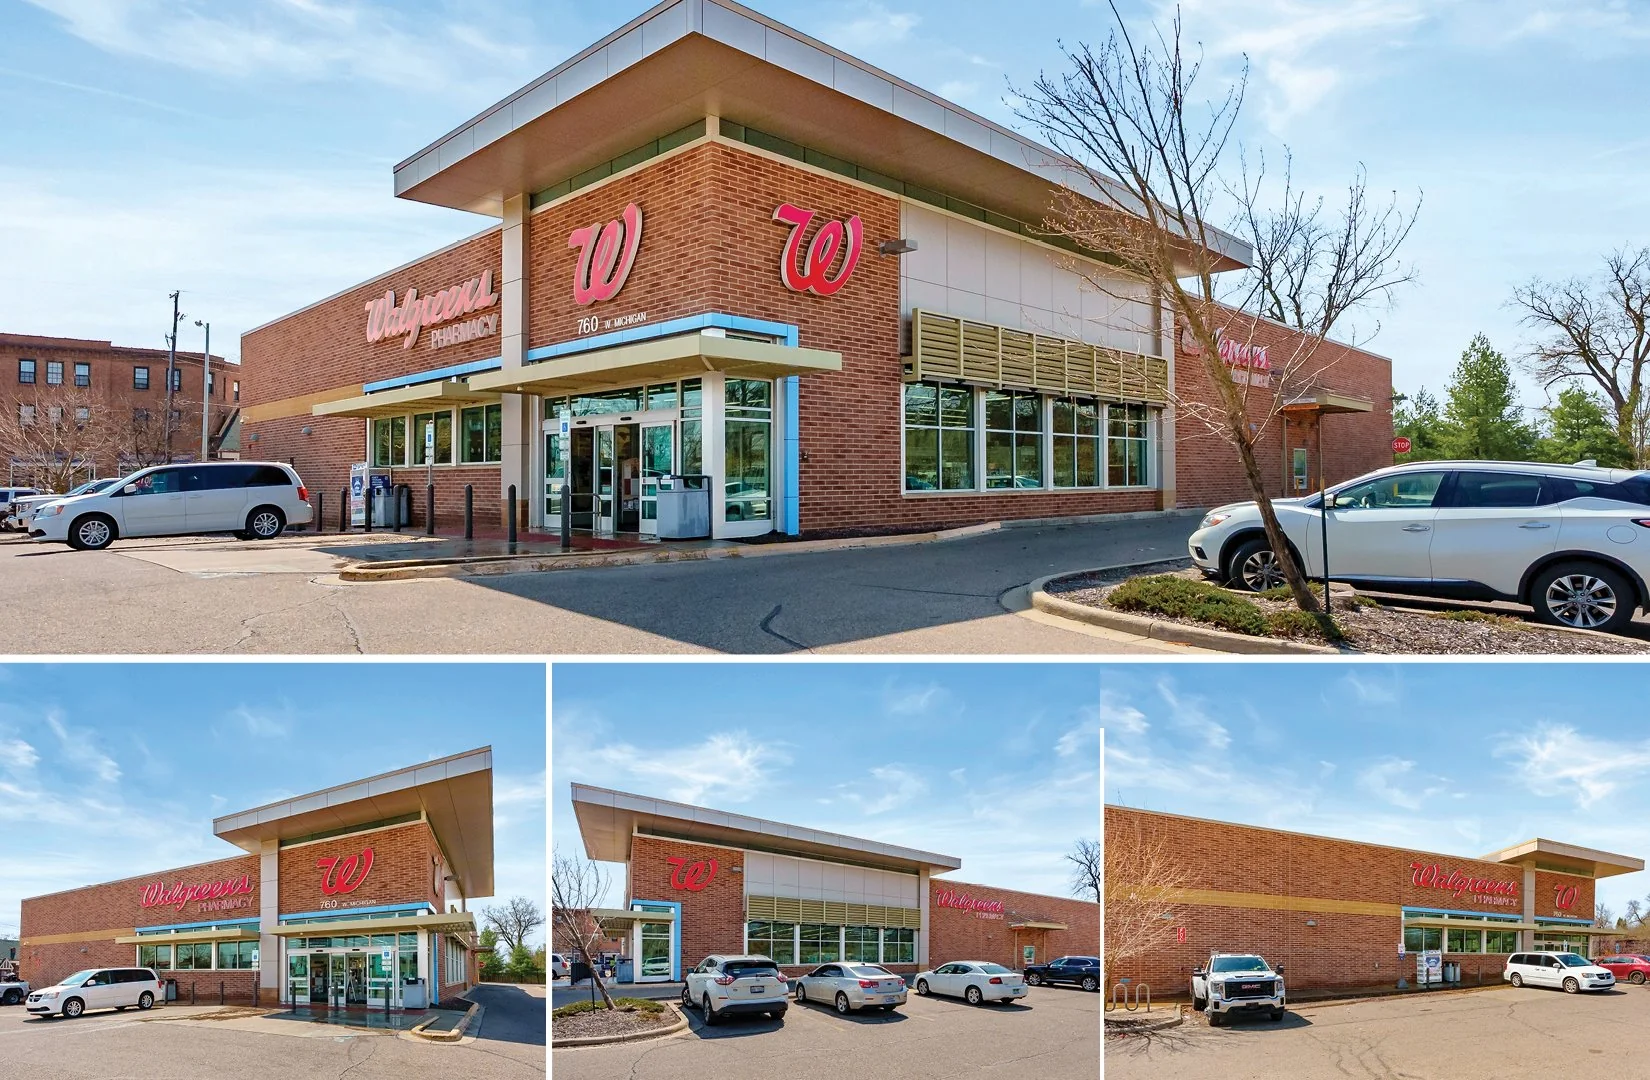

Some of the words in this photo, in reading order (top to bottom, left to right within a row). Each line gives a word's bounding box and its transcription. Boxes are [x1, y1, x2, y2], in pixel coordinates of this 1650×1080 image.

[567, 202, 643, 305] W
[772, 203, 864, 296] W
[364, 269, 499, 350] Walgreens
[577, 315, 599, 335] 760
[605, 319, 611, 329] W
[614, 312, 647, 328] MICHIGAN
[431, 313, 499, 350] PHARMACY
[1393, 441, 1410, 449] STOP
[316, 847, 374, 896] W
[666, 855, 719, 892] W
[1409, 861, 1519, 898] Walgreens
[138, 875, 254, 912] Walgreens
[197, 896, 254, 912] PHARMACY
[320, 899, 338, 909] 760
[935, 888, 1004, 917] Walgreens
[1553, 884, 1580, 910] W
